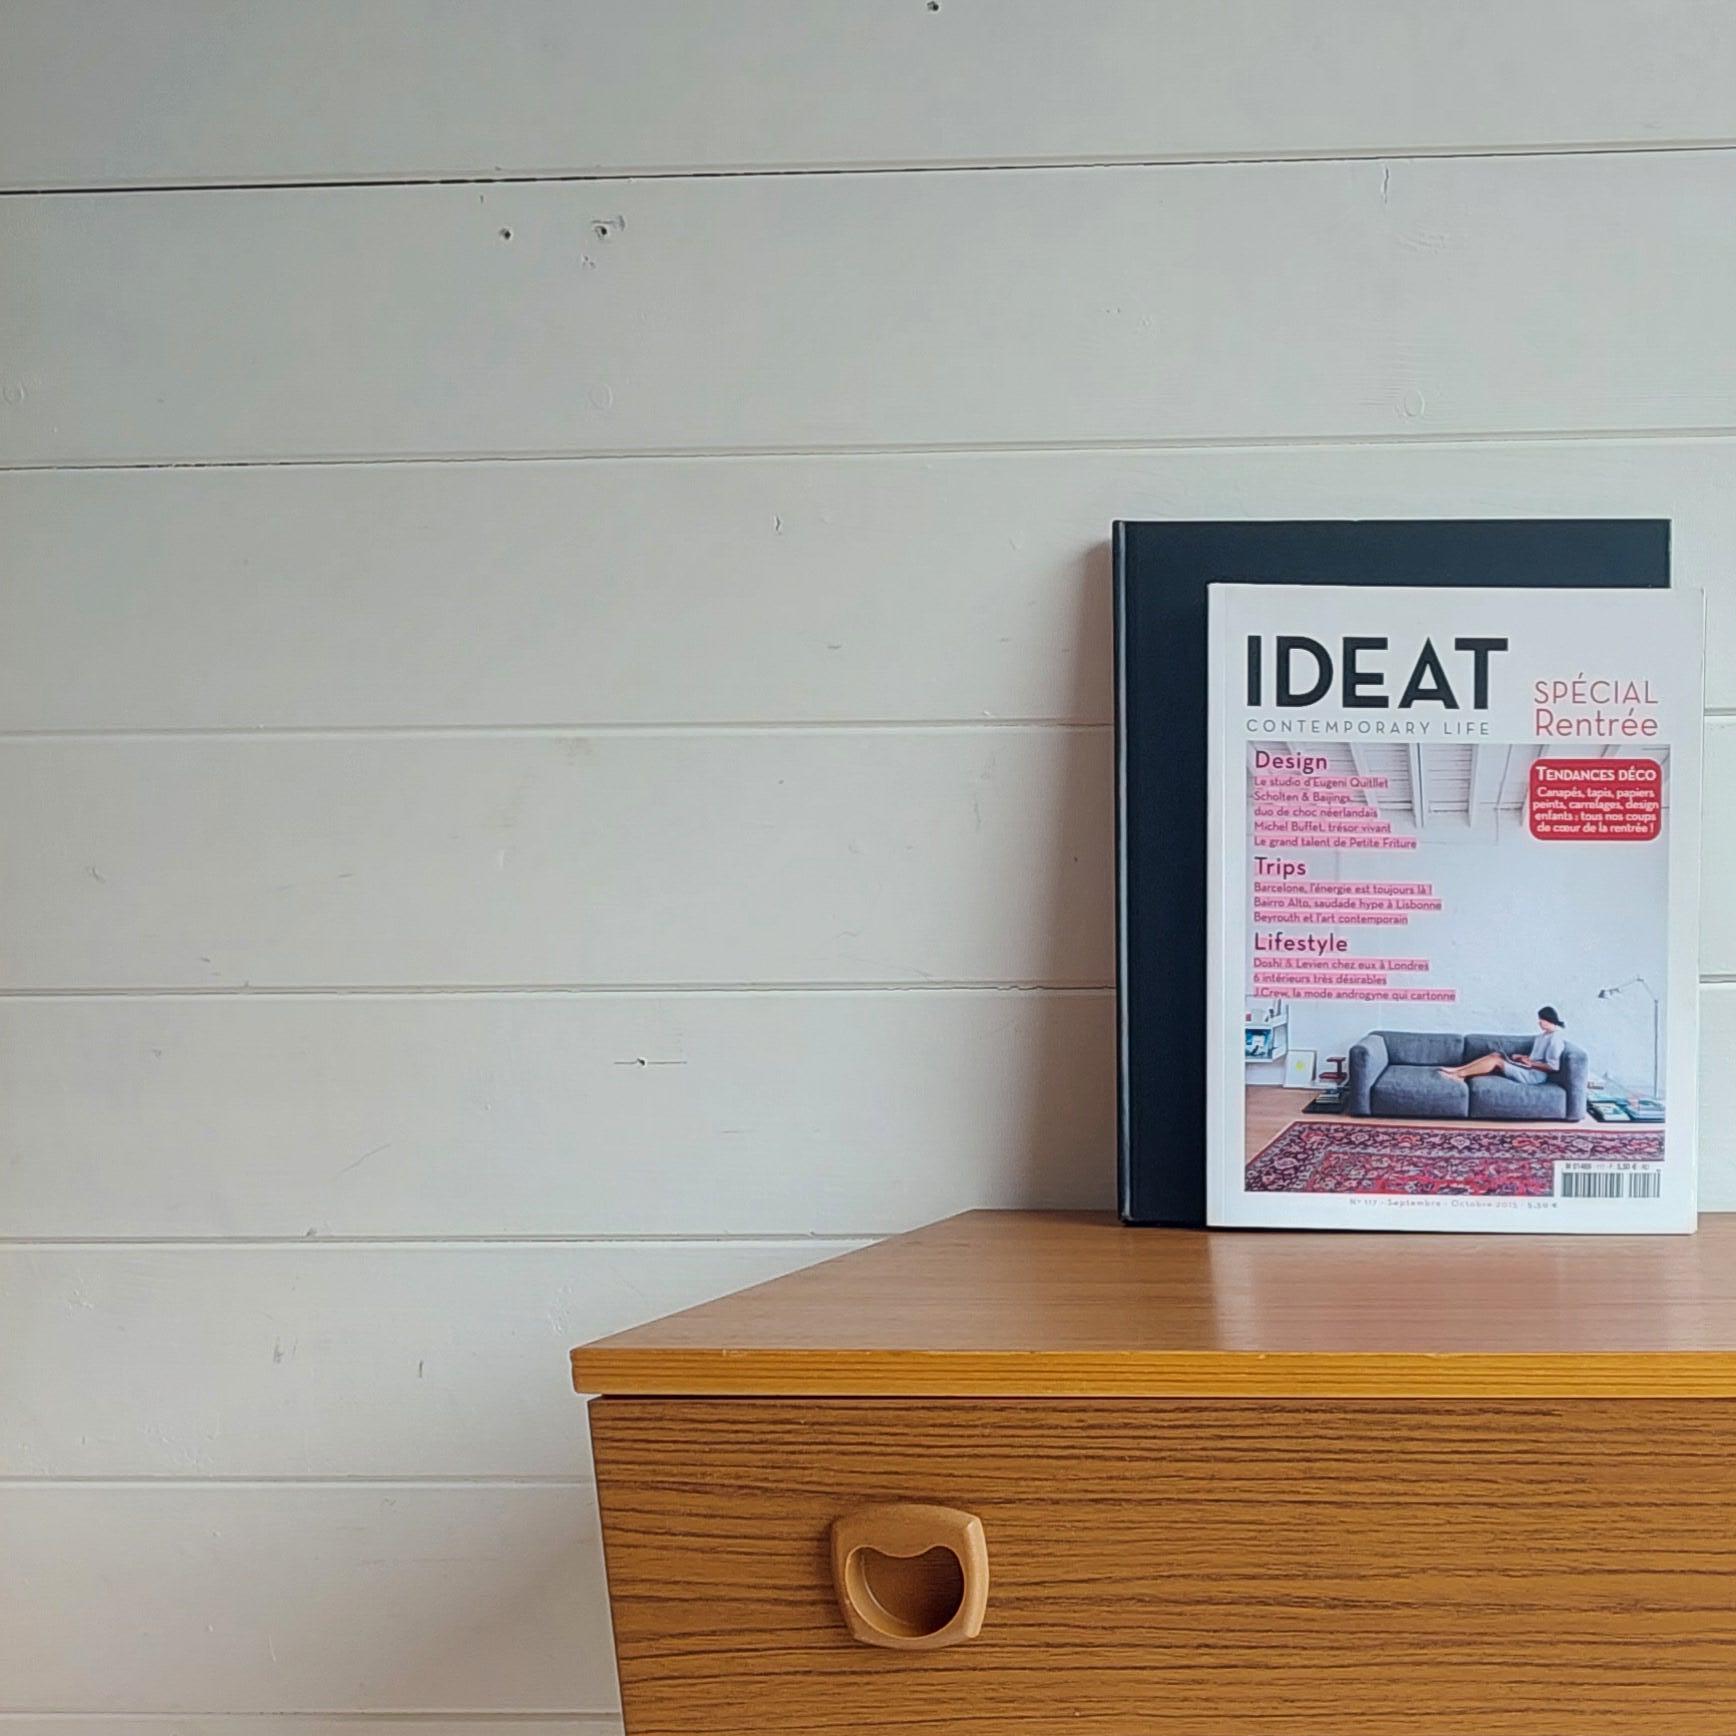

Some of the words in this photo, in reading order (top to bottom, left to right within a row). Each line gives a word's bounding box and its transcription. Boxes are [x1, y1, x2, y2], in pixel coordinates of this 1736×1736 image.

[1246, 635, 1509, 709] IDEAT
[1534, 671, 1659, 704] SPÉCIAL
[1246, 718, 1431, 735] CONTEMPORARY
[1443, 721, 1490, 735] LIFE
[1535, 707, 1659, 737] Rentrée
[1255, 750, 1328, 774] Design
[1254, 777, 1267, 787] Le
[1269, 776, 1301, 787] studio
[1254, 791, 1299, 801] Scholten
[1301, 791, 1309, 801] &
[1616, 788, 1655, 801] papiers
[1254, 806, 1274, 817] duo
[1276, 807, 1290, 817] de
[1292, 807, 1317, 818] choc
[1319, 808, 1378, 819] néerlandais
[1625, 800, 1660, 812] design
[1534, 810, 1573, 821] enfants
[1580, 811, 1603, 821] tous
[1604, 813, 1624, 821] nos
[1625, 813, 1657, 823] coups
[1254, 821, 1289, 832] Michel
[1328, 822, 1359, 833] trésor
[1360, 823, 1391, 834] vivant
[1536, 822, 1551, 832] de
[1582, 822, 1597, 833] de
[1598, 822, 1608, 833] la
[1609, 822, 1649, 833] rentrée
[1254, 836, 1267, 847] Le
[1269, 837, 1298, 848] grand
[1301, 837, 1330, 848] talent
[1333, 837, 1347, 848] de
[1349, 837, 1380, 848] Petite
[1382, 838, 1417, 849] Friture
[1254, 856, 1307, 880] Trips
[1254, 882, 1308, 894] Barcelone,
[1354, 885, 1370, 894] est
[1373, 883, 1415, 897] toujours
[1417, 883, 1427, 895] là
[1254, 897, 1286, 909] Bairro
[1288, 898, 1312, 909] Alto,
[1314, 898, 1357, 910] saudade
[1359, 899, 1384, 913] hype
[1387, 898, 1394, 909] à
[1396, 899, 1442, 911] Lisbonne
[1254, 912, 1300, 925] Beyrouth
[1303, 912, 1314, 923] et
[1338, 914, 1408, 926] contemporain
[1254, 931, 1348, 956] Lifestyle
[1253, 957, 1282, 969] Doshi
[1285, 958, 1293, 969] &
[1296, 958, 1330, 969] Levien
[1332, 959, 1356, 970] chez
[1358, 961, 1376, 970] eux
[1379, 959, 1386, 971] à
[1388, 960, 1430, 972] Londres
[1253, 973, 1260, 983] 6
[1262, 973, 1311, 984] intérieurs
[1313, 974, 1333, 985] très
[1335, 974, 1387, 986] désirables
[1292, 987, 1301, 998] la
[1303, 988, 1333, 999] mode
[1335, 988, 1390, 1002] androgyne
[1392, 989, 1408, 1002] qui
[1410, 990, 1456, 1002] cartonne
